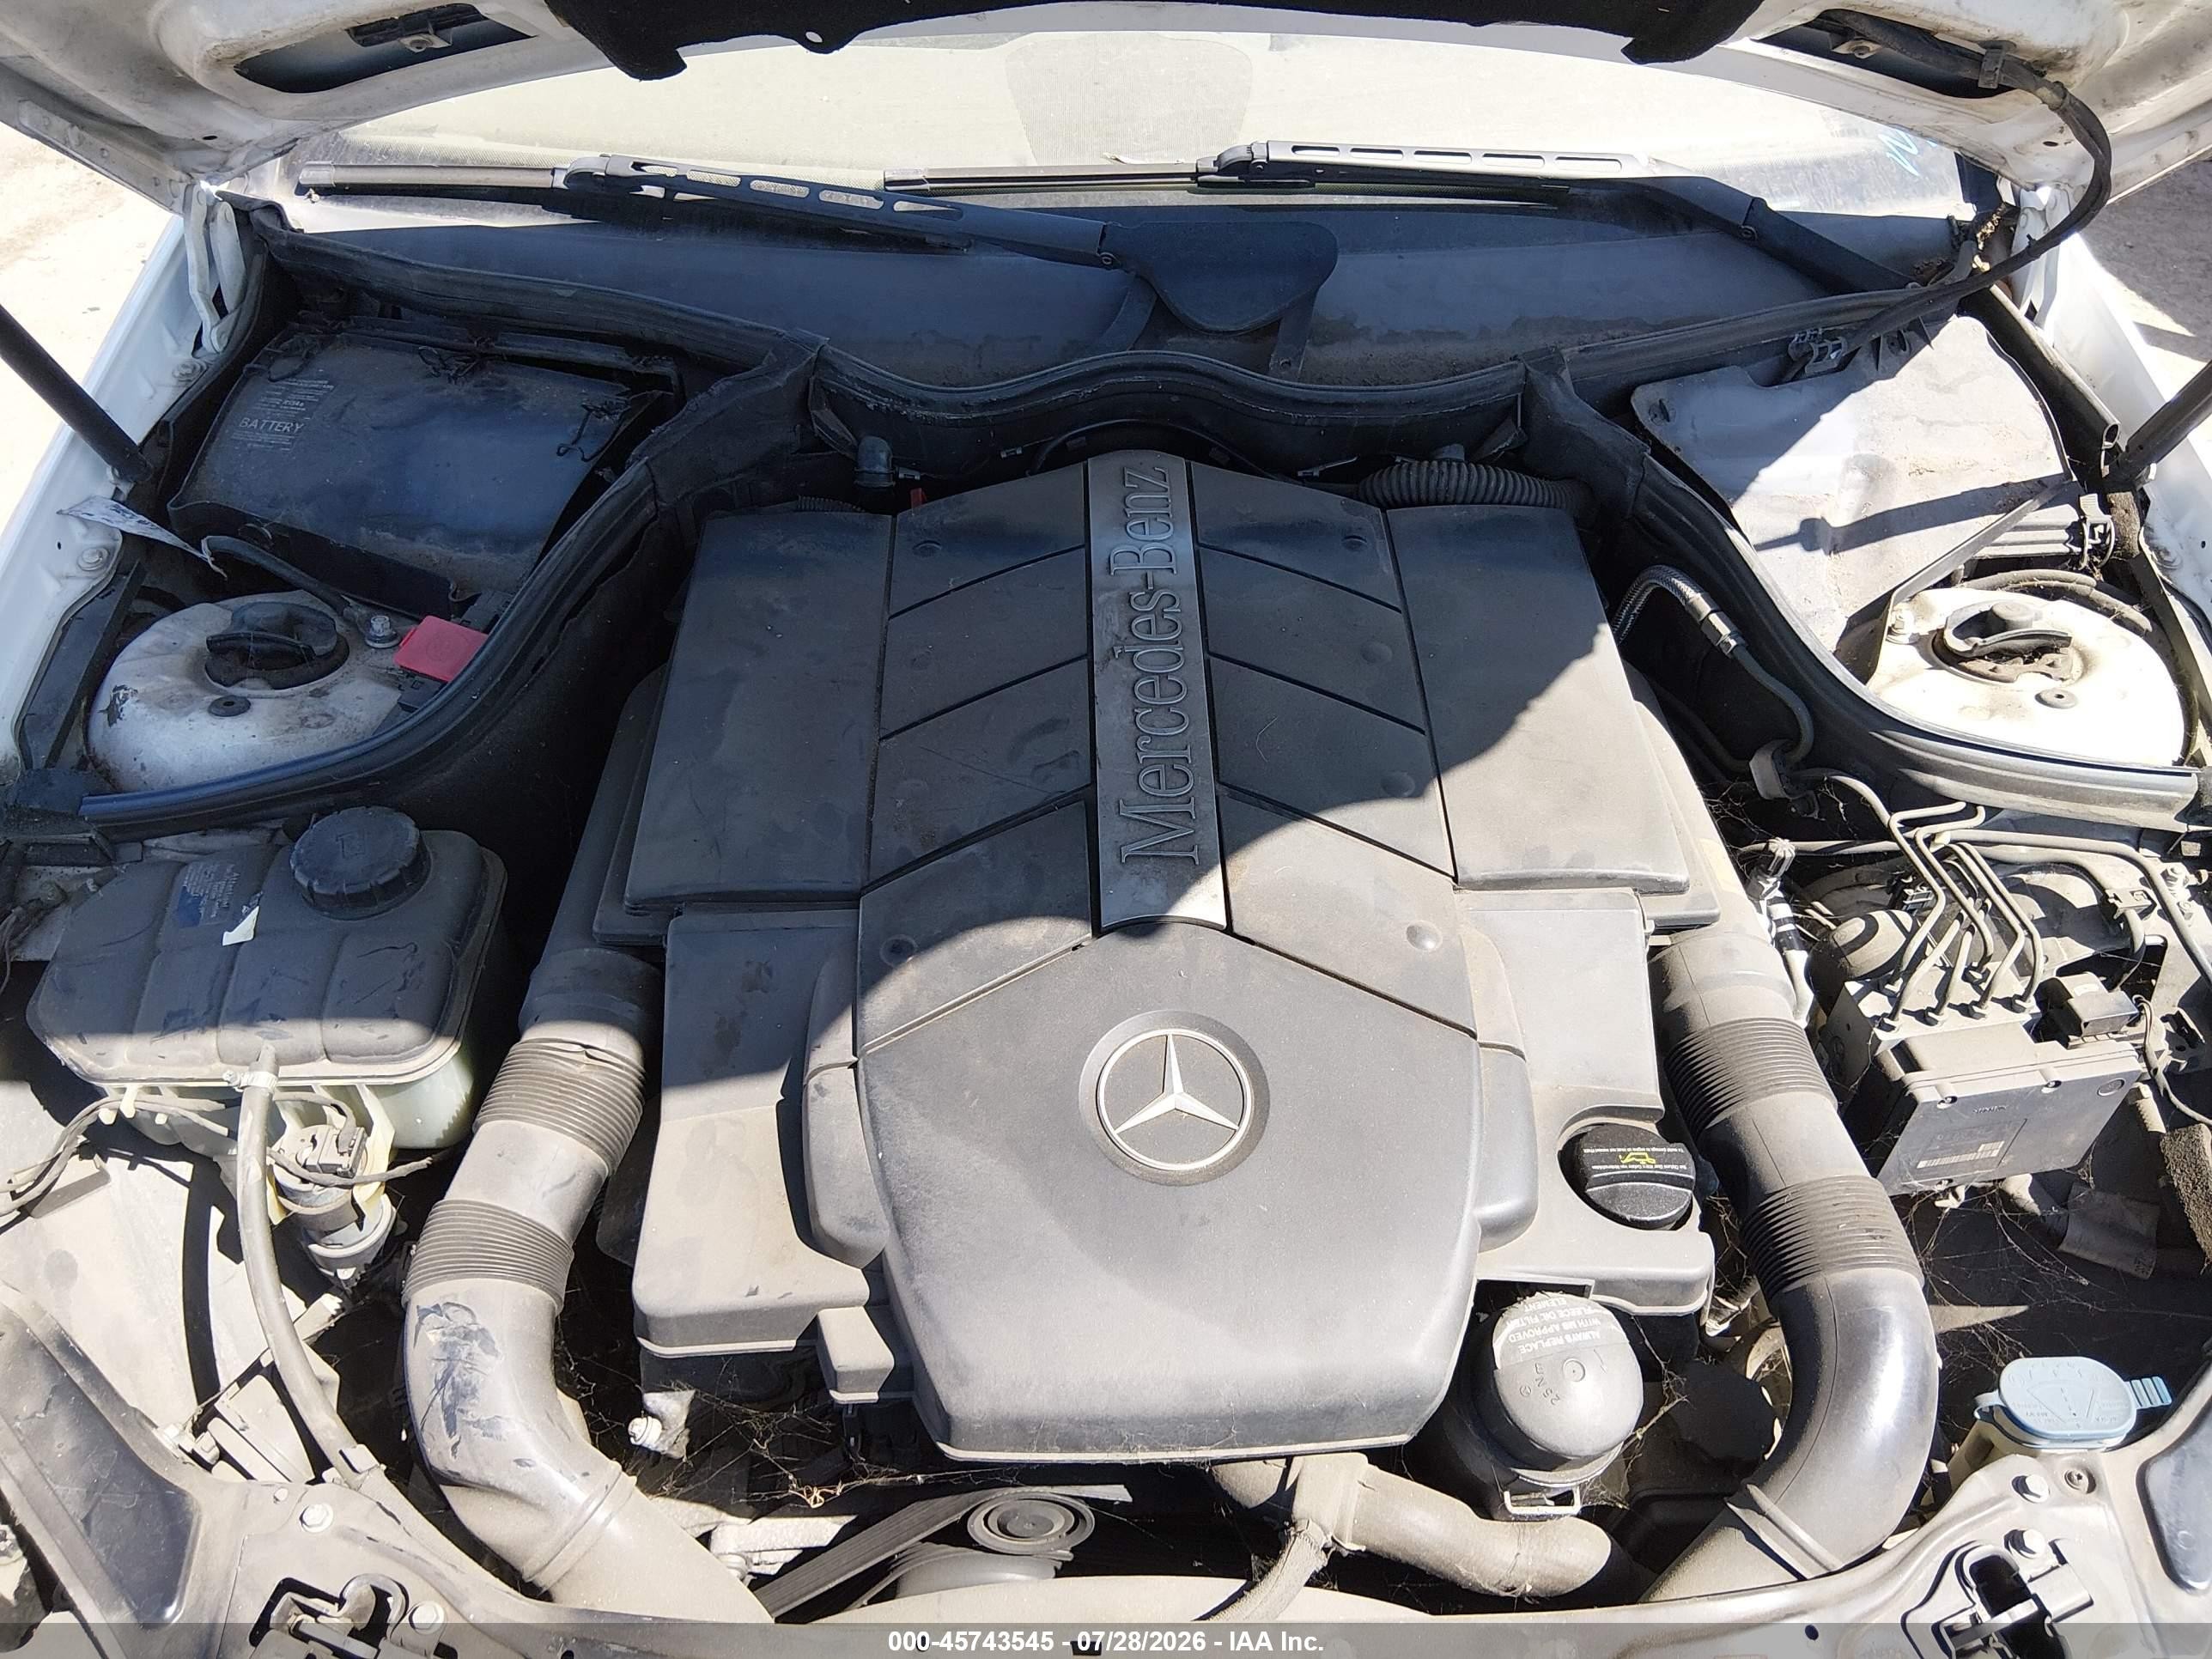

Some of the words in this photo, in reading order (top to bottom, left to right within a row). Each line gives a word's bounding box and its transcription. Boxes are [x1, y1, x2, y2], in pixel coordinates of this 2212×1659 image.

[239, 417, 304, 434] BATTERY
[1109, 466, 1200, 866] Mercedes-Benz
[1524, 1297, 1567, 1312] ELEMENT
[1577, 1317, 1601, 1328] WITH
[1509, 1323, 1560, 1342] APPROVED
[1565, 1330, 1601, 1343] ALWAYS
[1518, 1335, 1565, 1353] REPLACE
